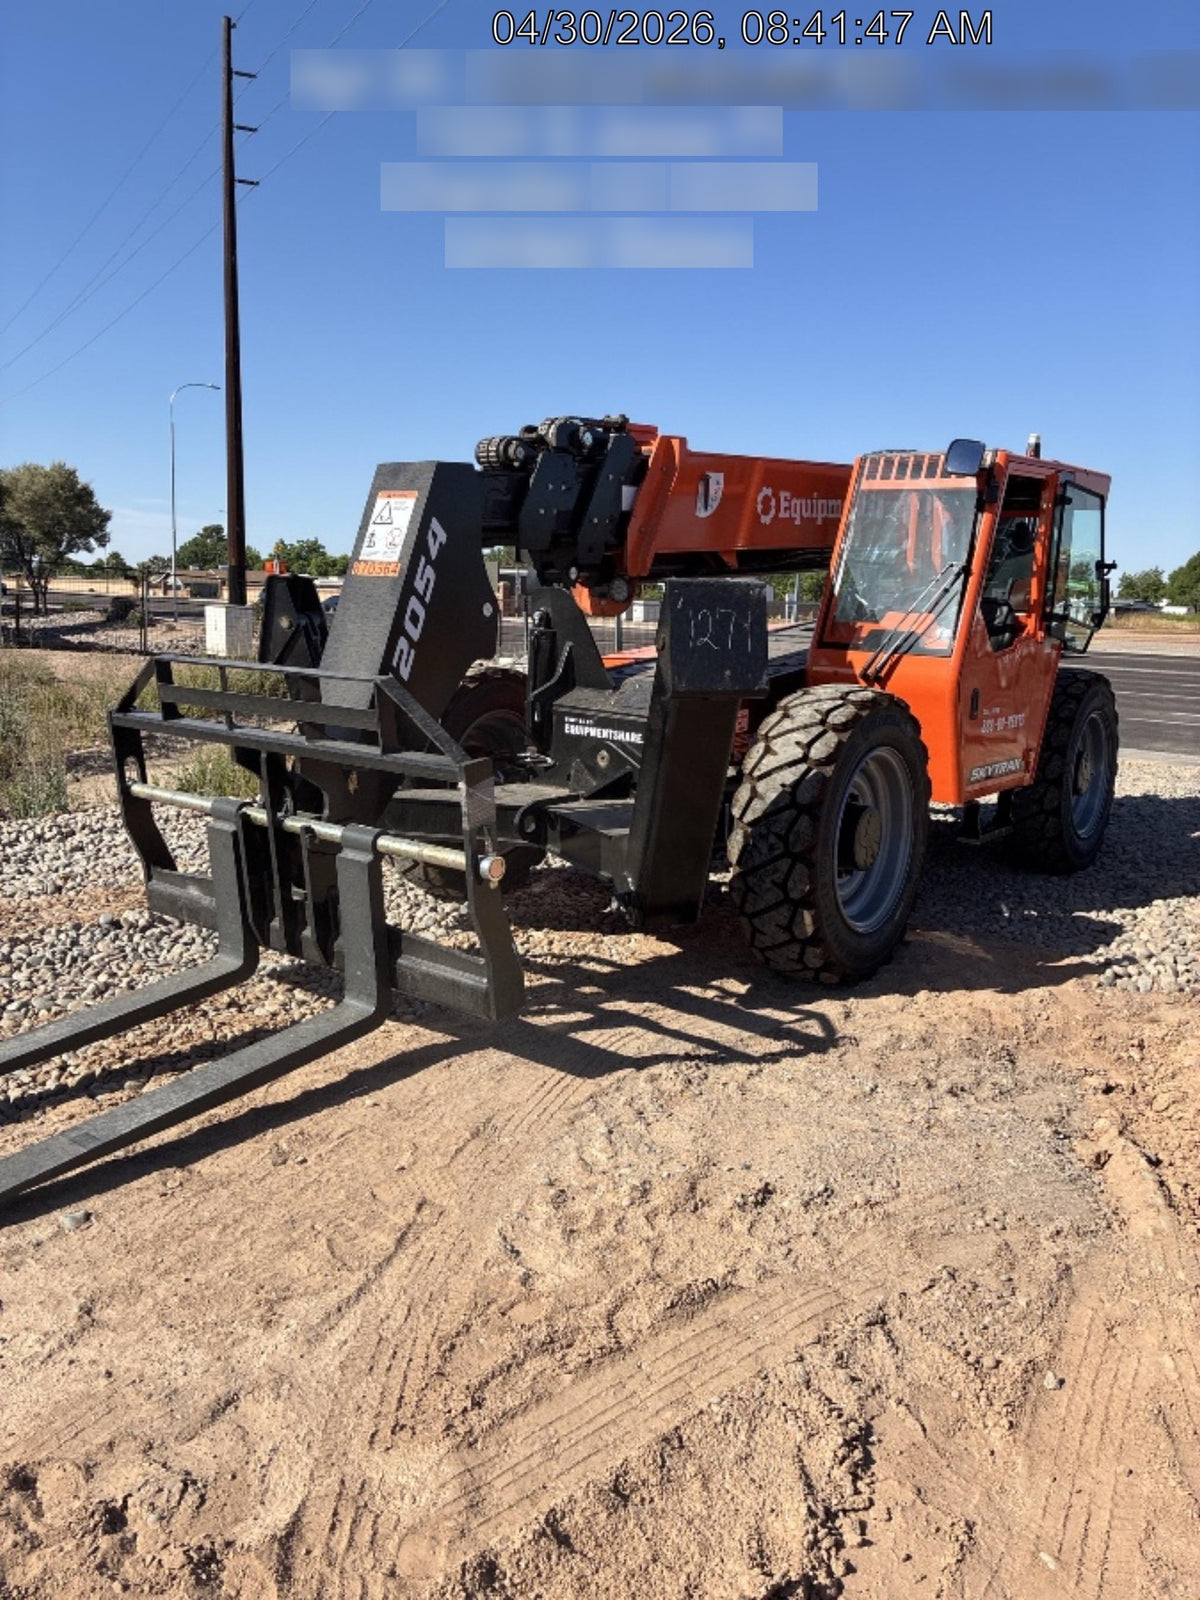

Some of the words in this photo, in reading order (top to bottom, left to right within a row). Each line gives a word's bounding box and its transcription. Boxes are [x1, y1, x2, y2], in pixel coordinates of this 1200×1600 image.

[392, 516, 448, 682] 2054
[689, 608, 751, 653] 1271
[564, 723, 645, 743] EQUIPMENTSHARE
[970, 758, 1023, 782] SKYTRAK
